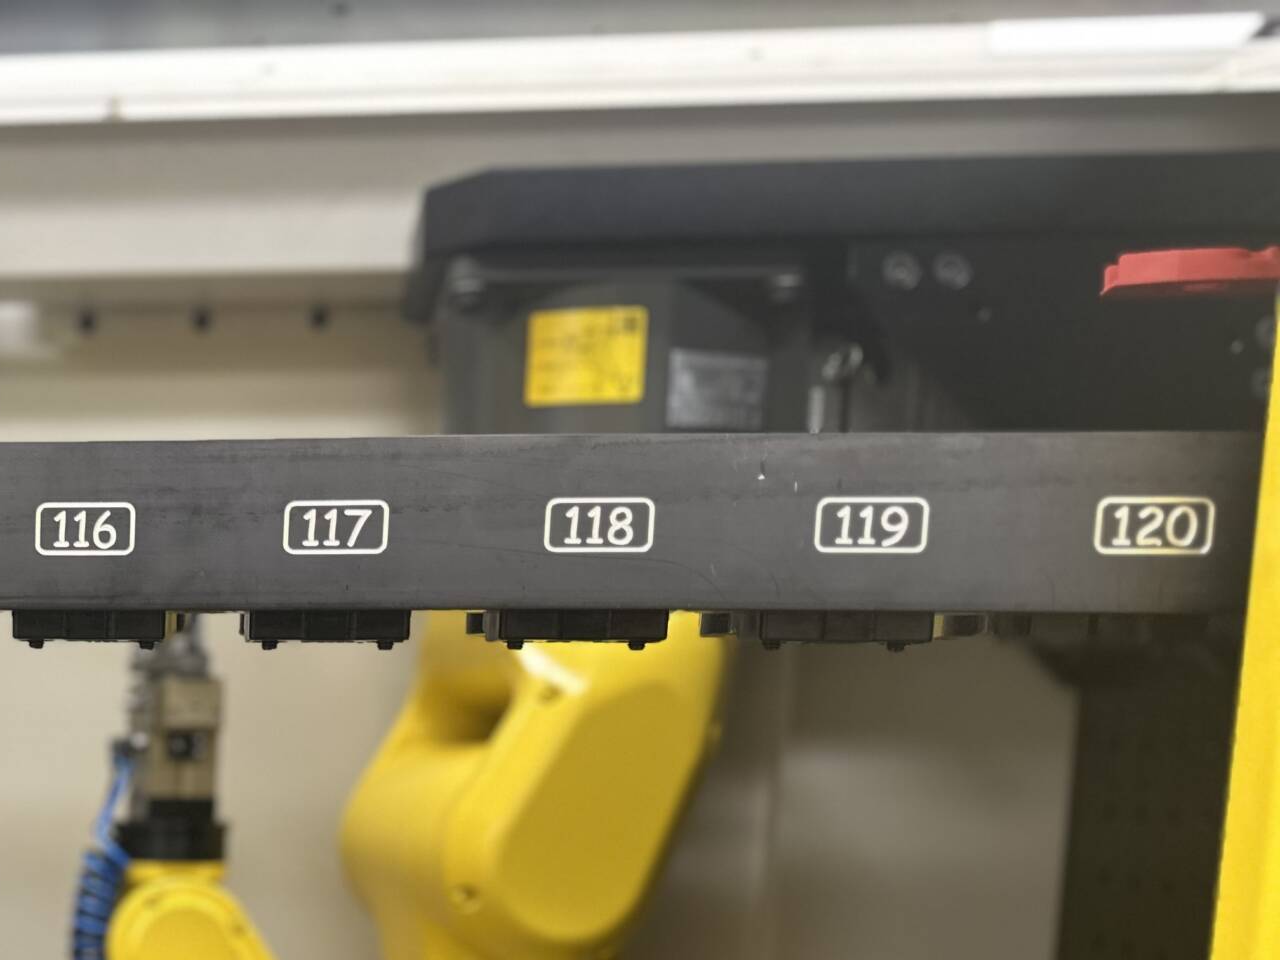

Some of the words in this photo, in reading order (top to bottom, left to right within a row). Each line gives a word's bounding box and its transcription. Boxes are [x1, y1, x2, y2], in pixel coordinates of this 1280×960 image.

[53, 509, 118, 549] 116
[302, 508, 373, 548] 117
[564, 504, 634, 547] 118
[834, 504, 909, 547] 119
[1111, 505, 1201, 549] 120
